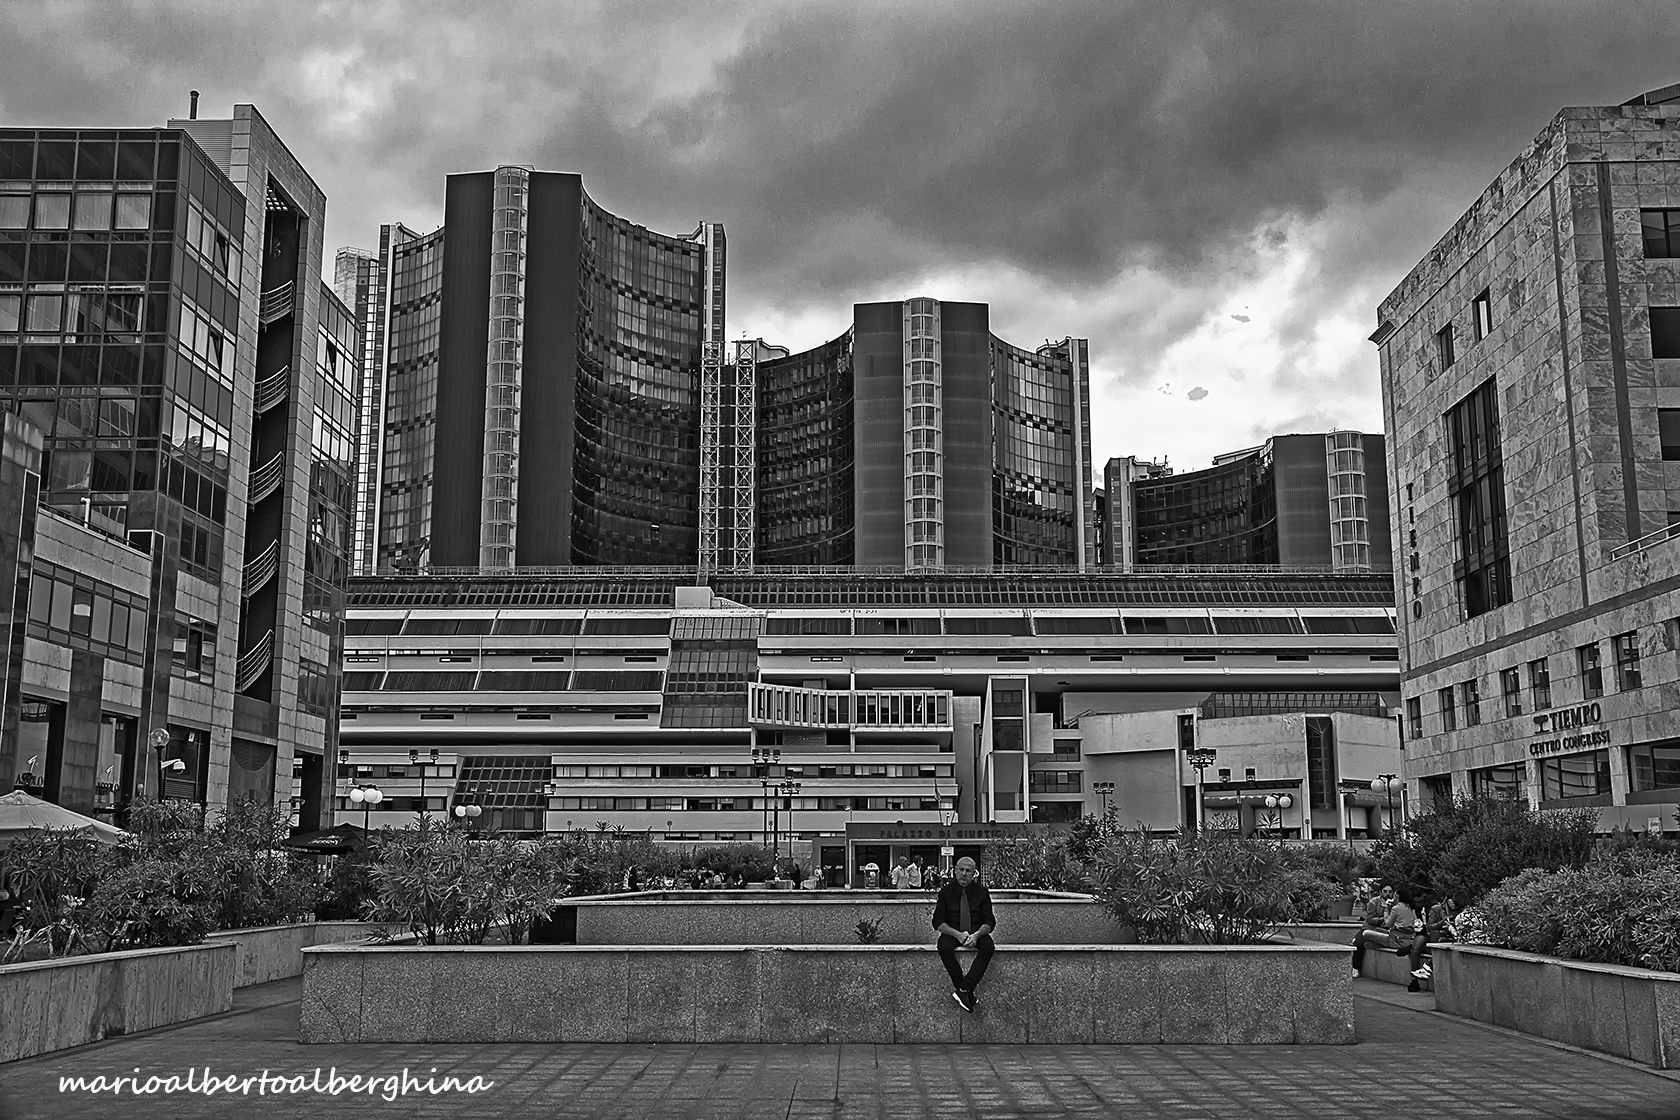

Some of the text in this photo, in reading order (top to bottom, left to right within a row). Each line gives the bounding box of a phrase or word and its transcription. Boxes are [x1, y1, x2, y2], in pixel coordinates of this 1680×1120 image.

[1406, 482, 1422, 619] TIEMPO
[1549, 702, 1602, 731] TIEMPO
[1529, 730, 1611, 756] CENTRO CONGRESSI
[880, 830, 933, 839] PALAZZO
